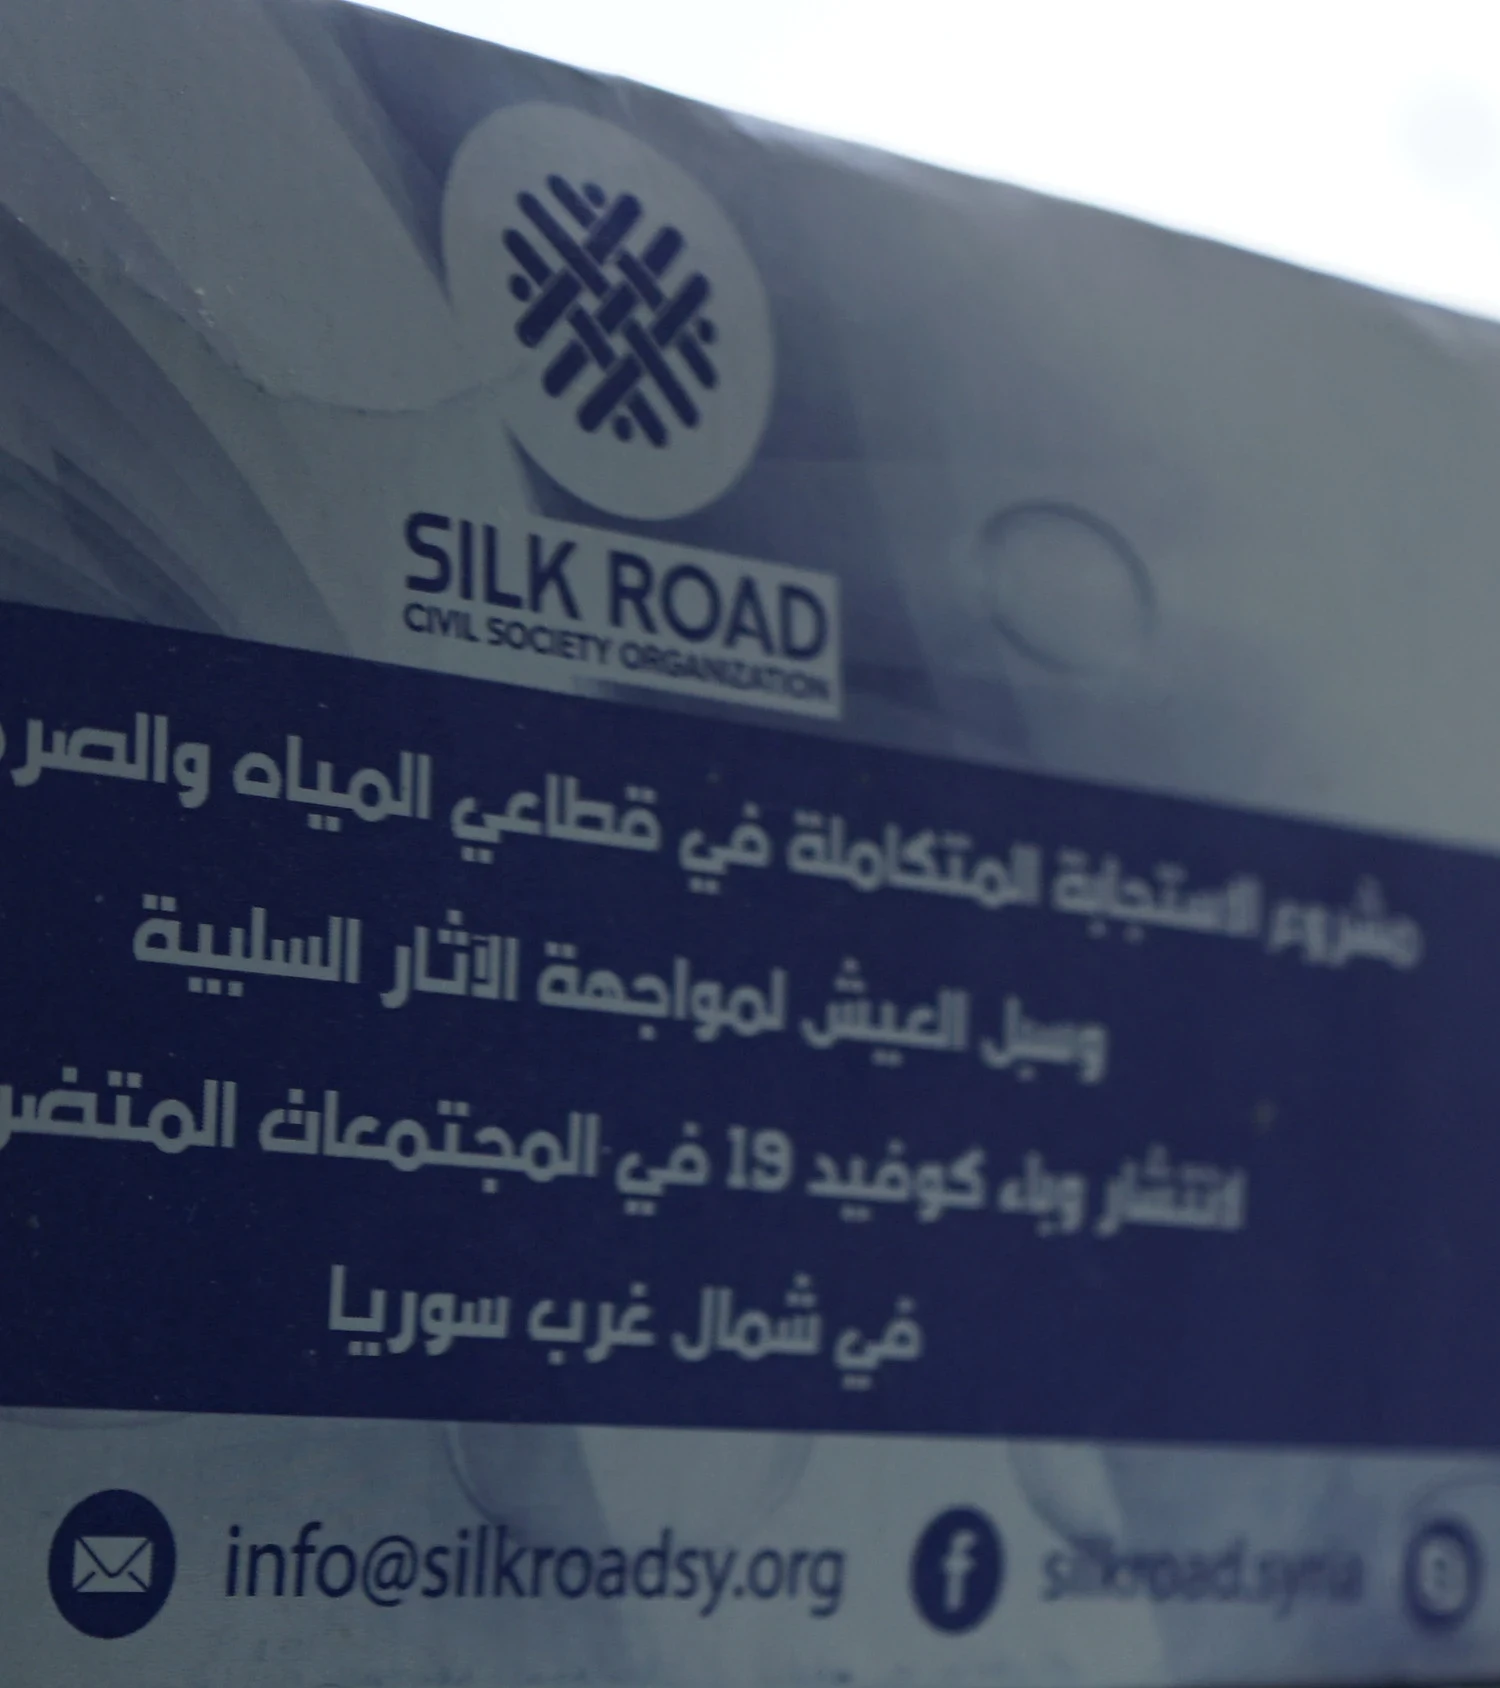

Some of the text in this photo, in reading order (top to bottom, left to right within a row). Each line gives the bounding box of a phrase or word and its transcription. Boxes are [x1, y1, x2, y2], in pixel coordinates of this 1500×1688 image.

[404, 511, 828, 662] SILK ROAD
[403, 603, 830, 700] CIVIL SOCIETY ORGANIZATION
[0, 712, 210, 809] والصر
[232, 734, 432, 832] المياه
[451, 773, 661, 864] قطاعي
[679, 804, 773, 895] في
[787, 808, 1042, 909] المتكاملة
[132, 894, 361, 997] السلبية
[537, 939, 787, 1041] لمواجهة
[800, 958, 970, 1067] العيش
[980, 995, 1109, 1082] وسبل
[259, 1088, 600, 1194] المجتمعات
[615, 1122, 712, 1216] في
[726, 1123, 795, 1191] 19
[807, 1137, 988, 1224] كوفيد
[328, 1264, 925, 1391] في شمال غرب سوريا
[225, 1521, 846, 1618] info@silkroadsy.org
